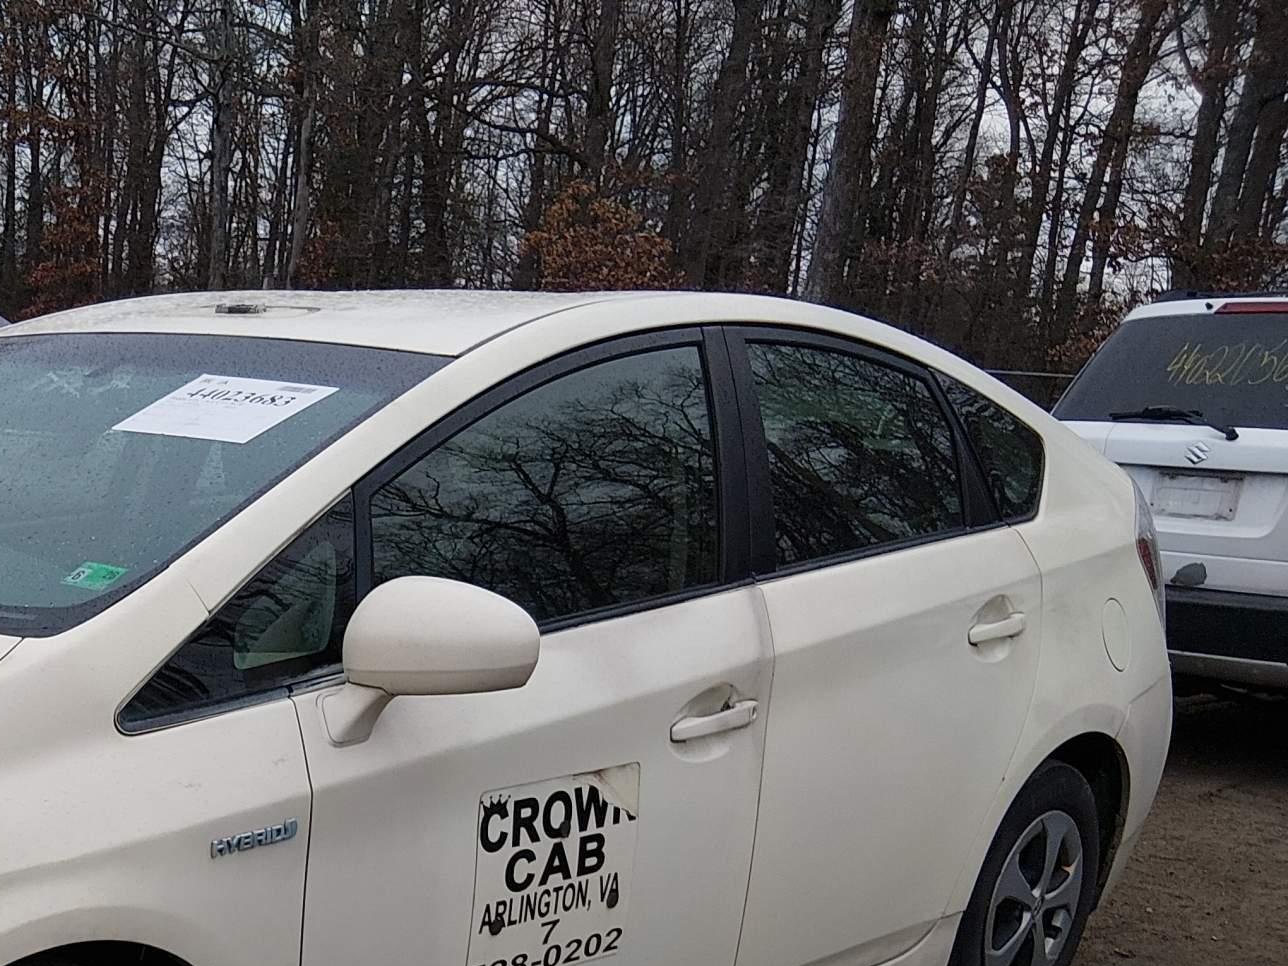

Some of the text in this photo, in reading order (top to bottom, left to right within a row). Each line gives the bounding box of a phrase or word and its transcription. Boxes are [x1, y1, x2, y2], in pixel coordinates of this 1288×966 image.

[186, 387, 297, 408] 44023683
[505, 833, 606, 892] CAB
[478, 872, 620, 935] ARLINGTON, VA
[540, 918, 561, 945] 7
